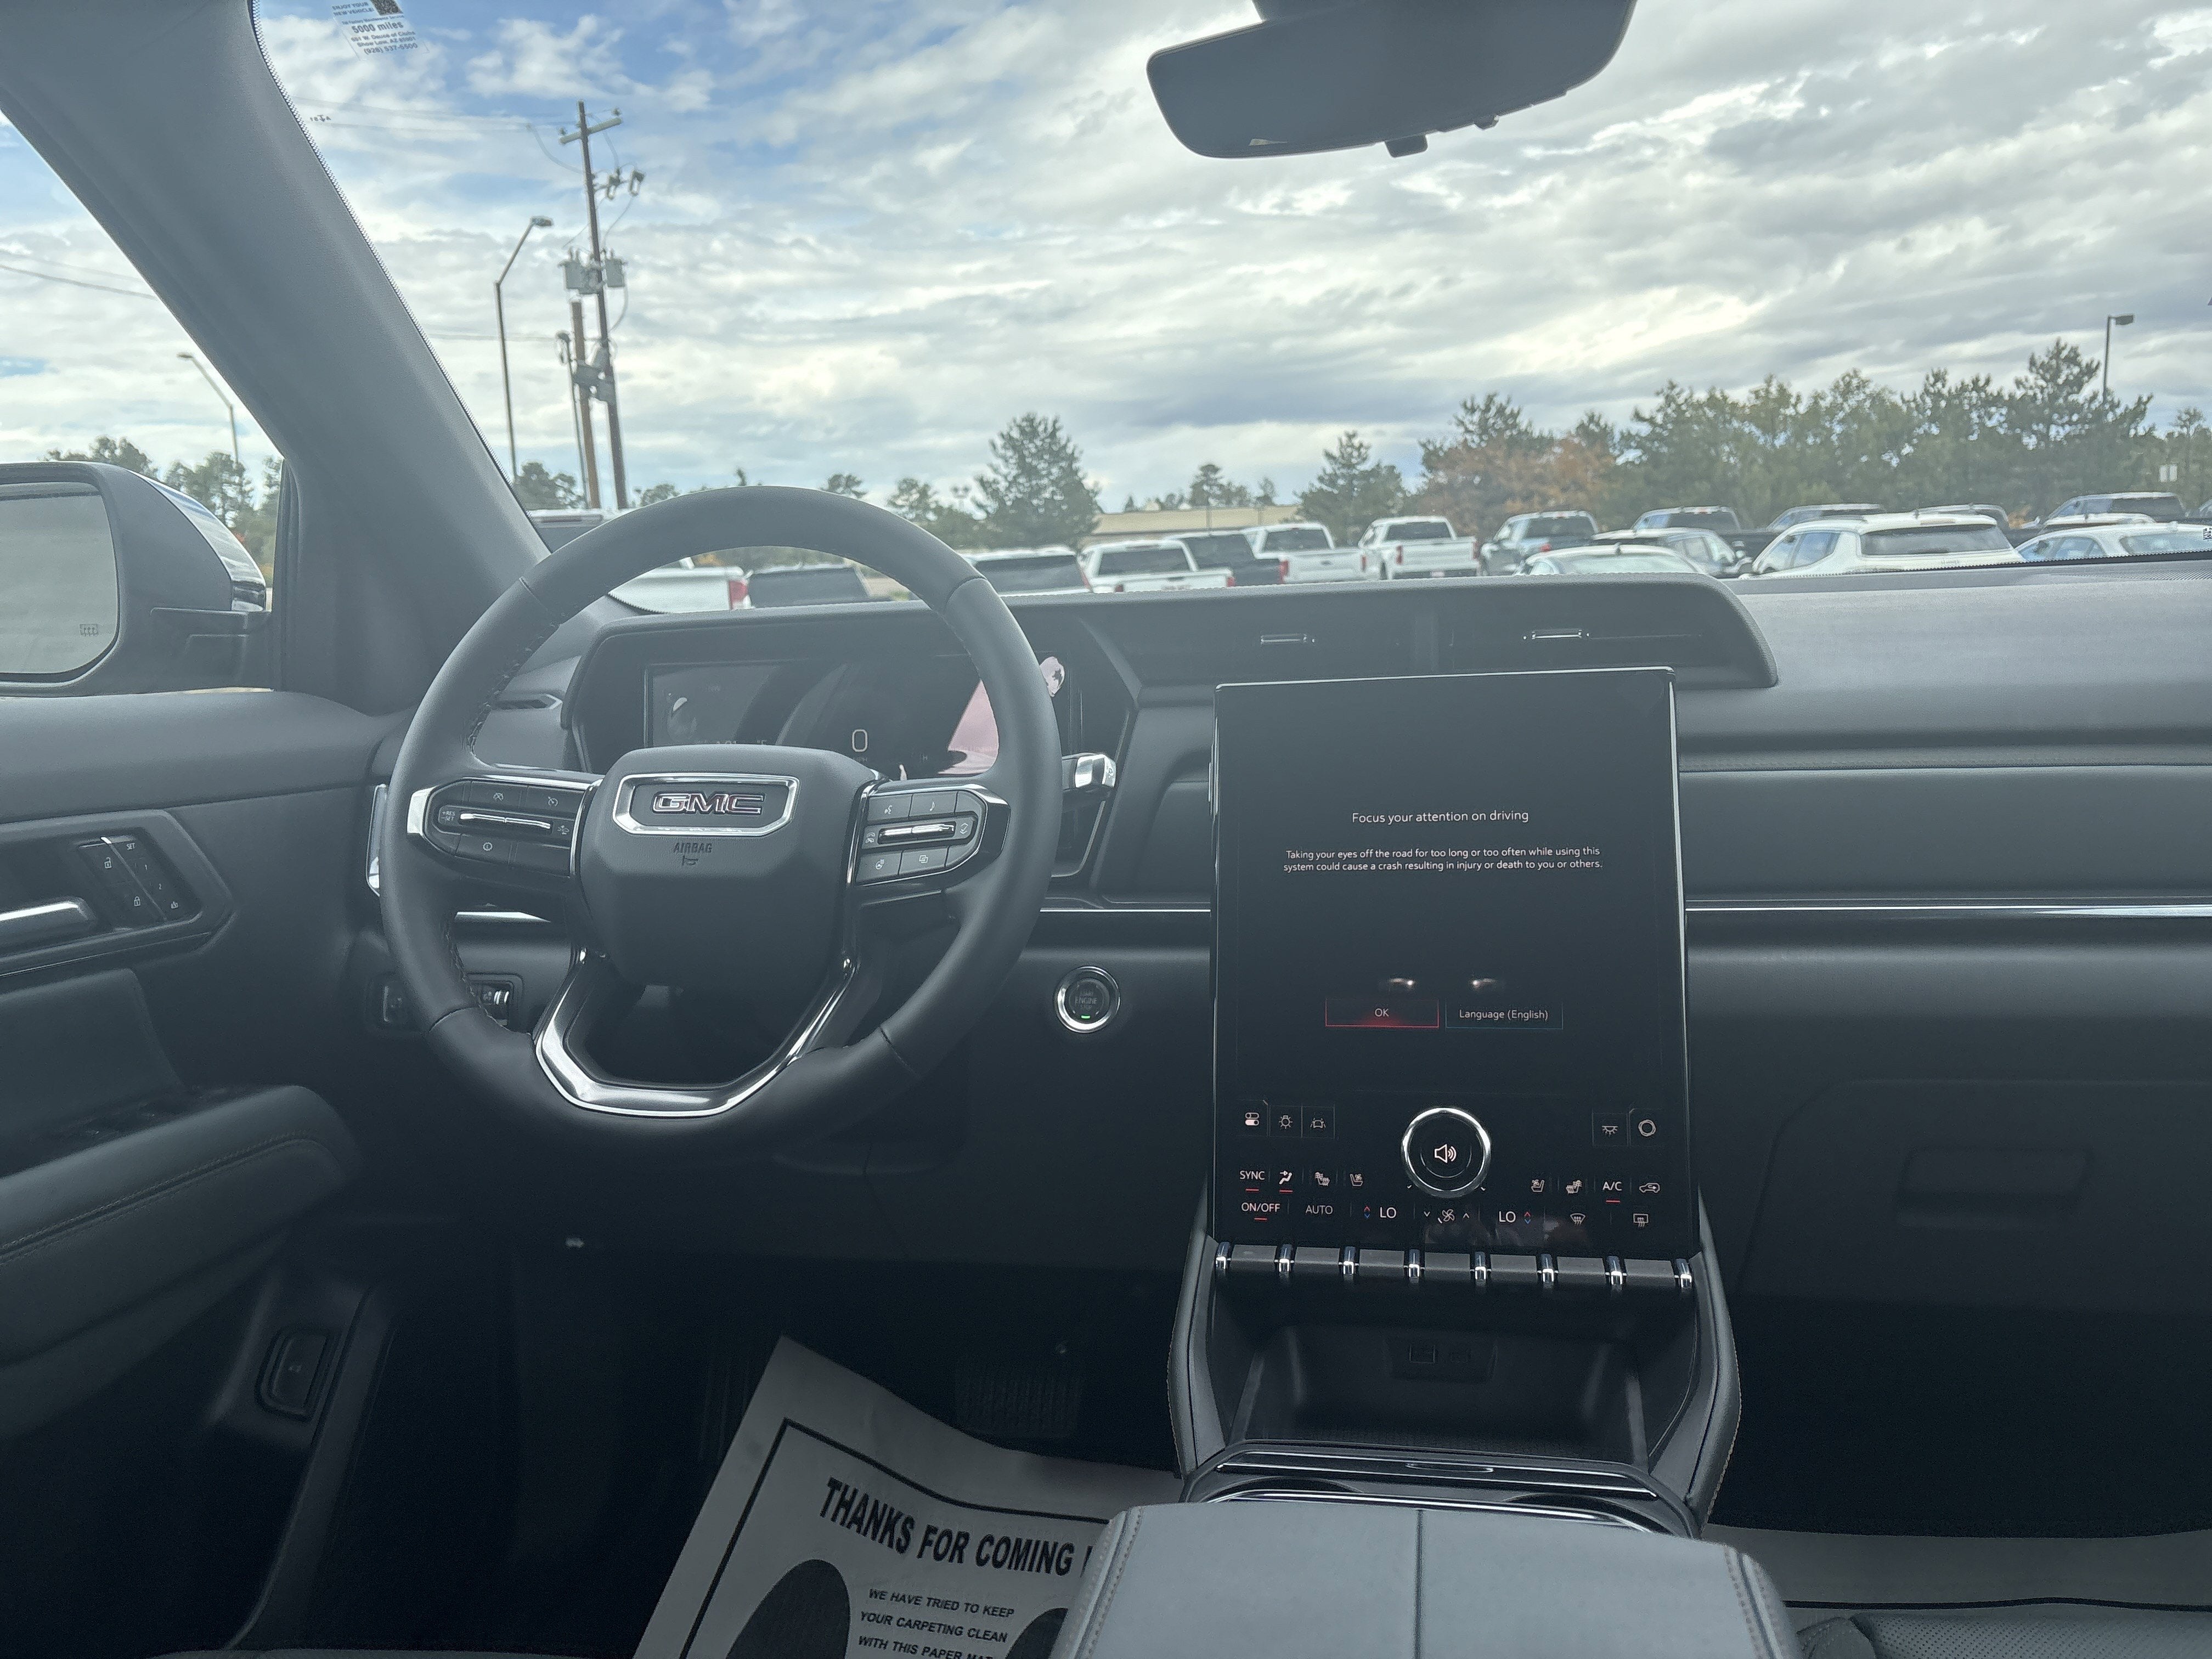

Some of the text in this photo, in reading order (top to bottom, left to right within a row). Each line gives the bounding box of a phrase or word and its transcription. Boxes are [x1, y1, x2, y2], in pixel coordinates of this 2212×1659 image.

[352, 21, 404, 33] 5000 miles
[852, 729, 868, 752] 0
[653, 793, 765, 814] GMC
[1352, 812, 1385, 823] Focus
[1388, 814, 1414, 825] your
[1415, 811, 1468, 822] attention
[1489, 810, 1529, 823] driving
[674, 842, 713, 854] AIRBAG
[1286, 850, 1314, 861] Taking
[1316, 851, 1335, 860] your
[1338, 851, 1358, 860] eyes
[1359, 849, 1374, 857] off
[1375, 849, 1390, 857] the
[1392, 848, 1413, 857] road
[1415, 848, 1429, 857] for
[1448, 848, 1469, 859] long
[1502, 847, 1526, 856] often
[1528, 847, 1553, 856] while
[1555, 848, 1580, 857] using
[1583, 847, 1600, 855] this
[1283, 864, 1314, 872] system
[1316, 862, 1340, 871] could
[1378, 861, 1403, 870] crash
[1405, 861, 1443, 871] resulting
[1446, 861, 1454, 869] in
[1457, 861, 1482, 871] injury
[1497, 860, 1523, 869] death
[1538, 862, 1555, 870] you
[1570, 859, 1603, 868] others.
[1374, 1008, 1389, 1018] OK
[1459, 1009, 1548, 1023] Language (English)
[1240, 1170, 1265, 1180] SYNC
[1602, 1181, 1622, 1193] A/C
[1242, 1203, 1280, 1212] ON/OFF
[1305, 1205, 1333, 1215] AUTO
[1380, 1207, 1397, 1218] LO
[1499, 1211, 1516, 1223] LO
[820, 1477, 916, 1554] THANKS
[917, 1523, 970, 1564] FOR
[975, 1534, 1075, 1576] COMING
[869, 1588, 1014, 1618] WE HAVE TRIED TO KEEP
[861, 1611, 1008, 1643] YOUR CARPETING CLEAN
[859, 1635, 962, 1659] WITH THIS PAPER
